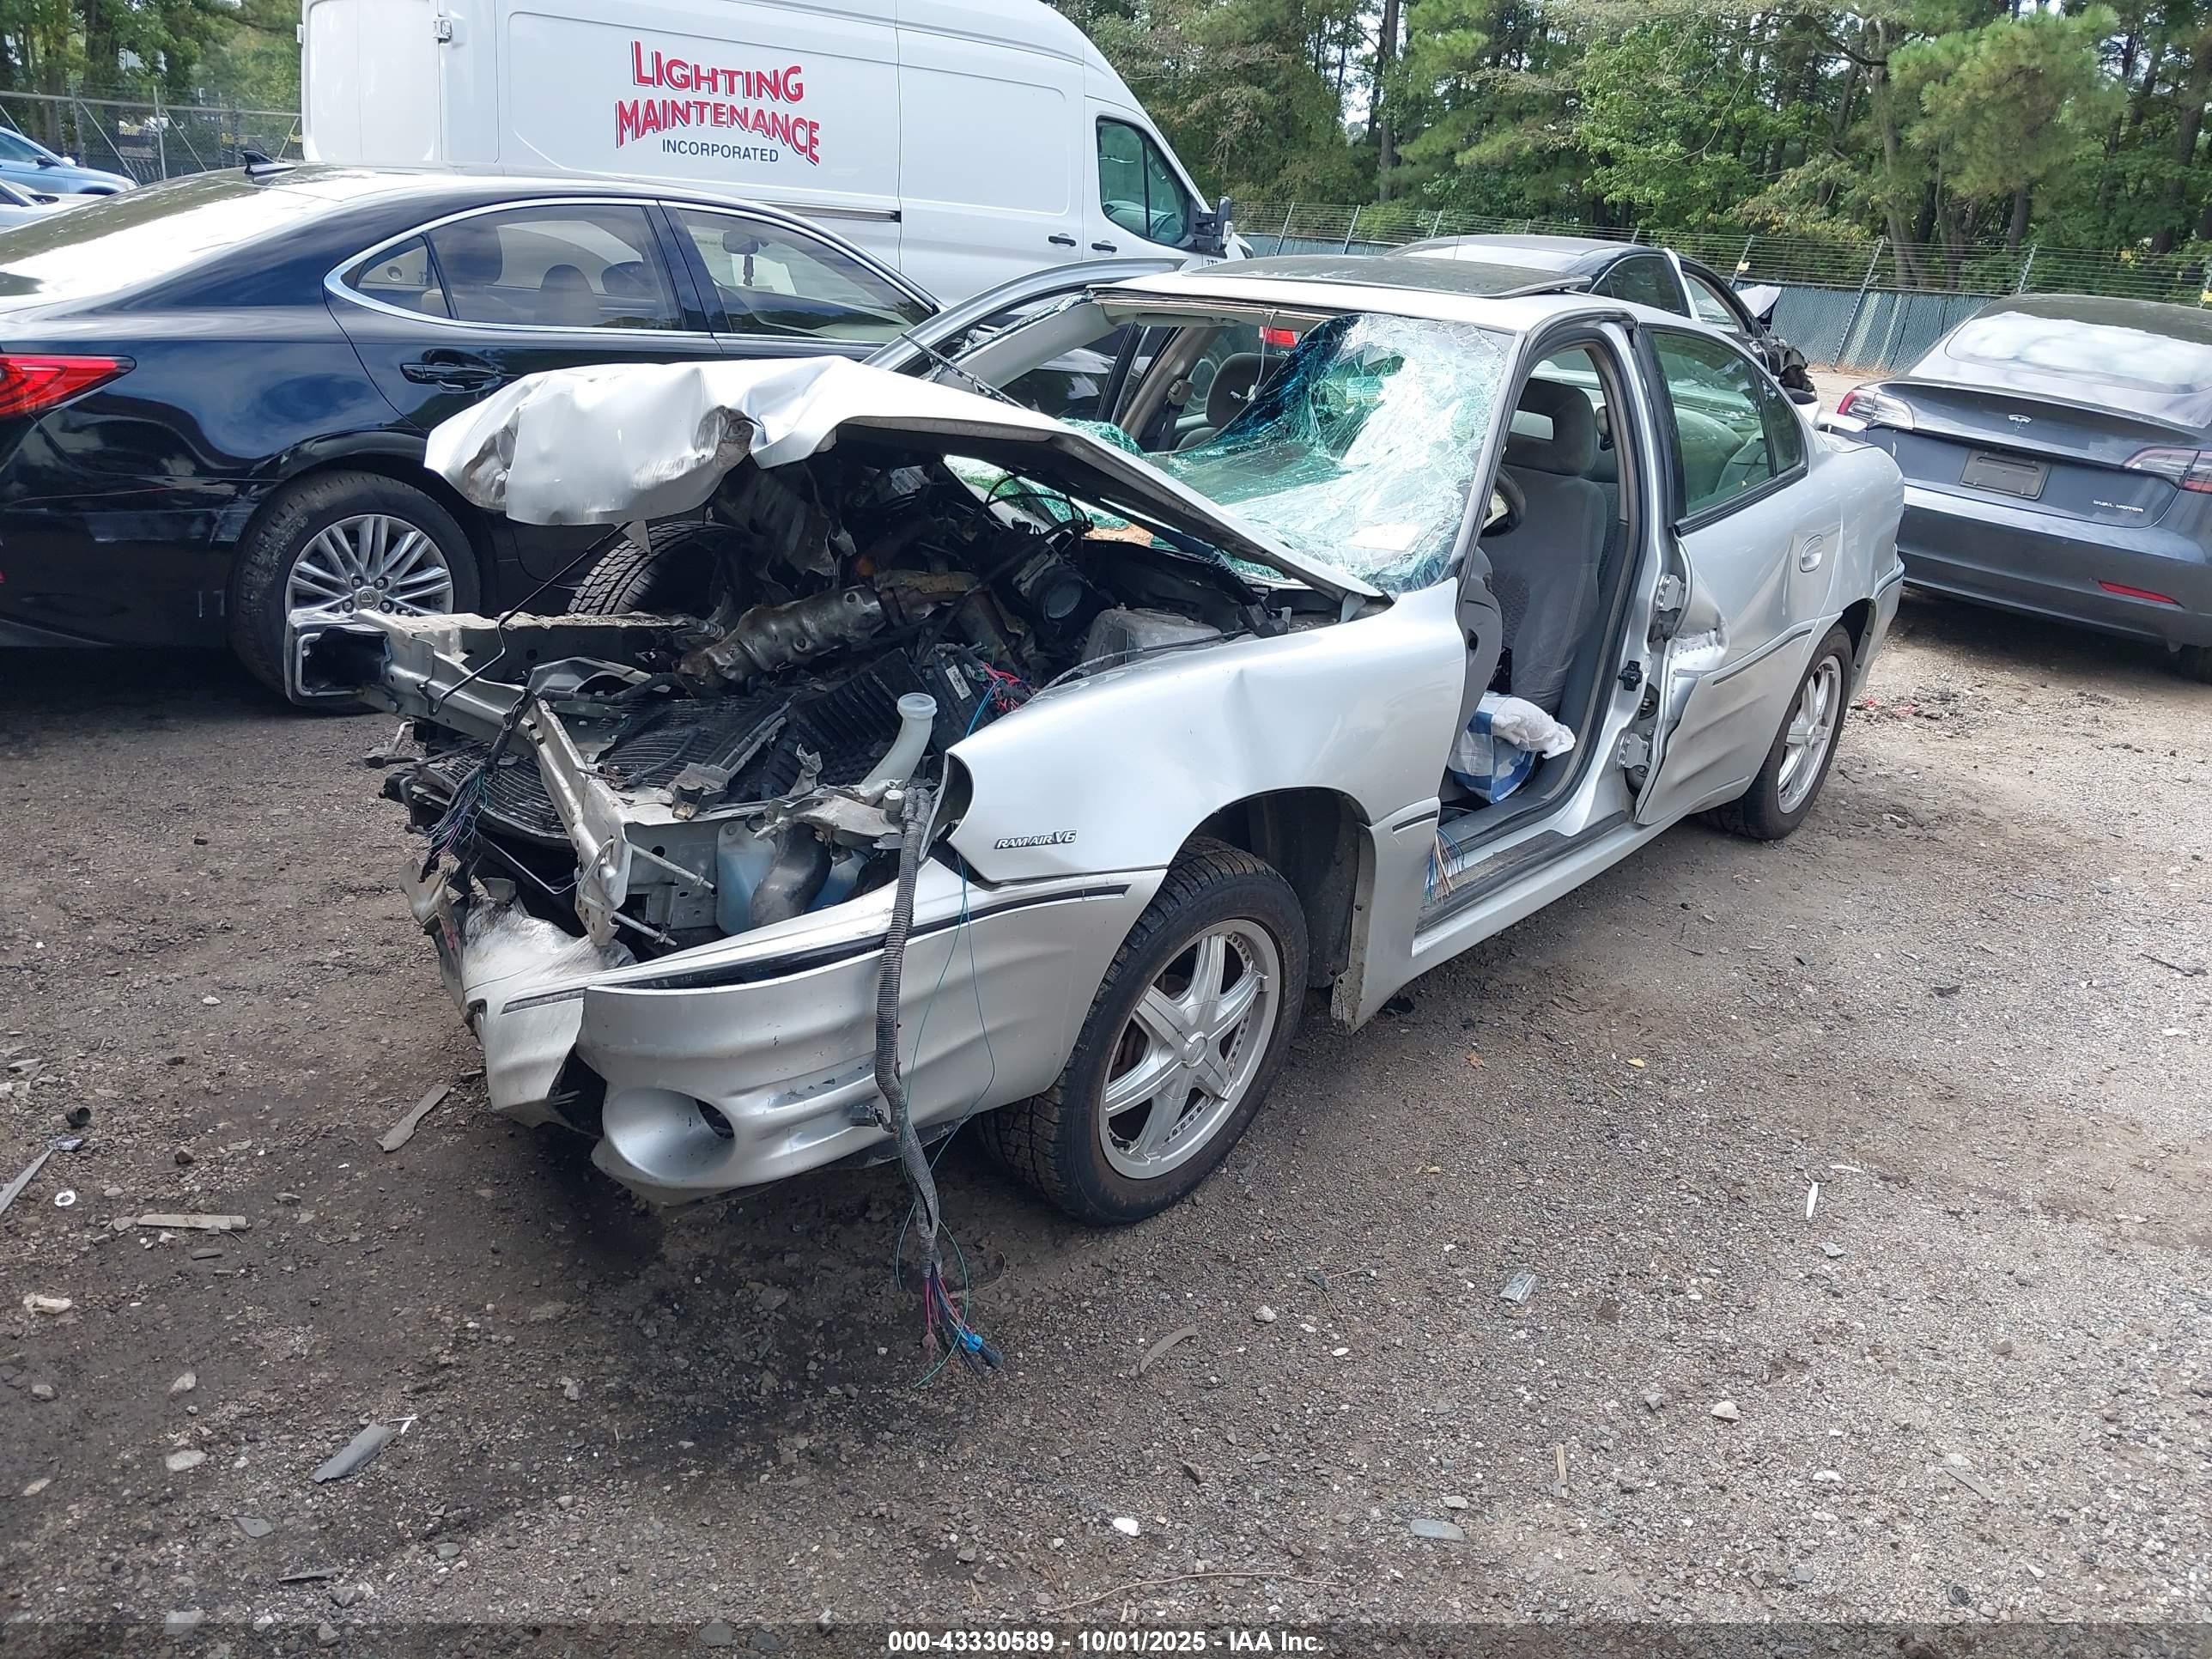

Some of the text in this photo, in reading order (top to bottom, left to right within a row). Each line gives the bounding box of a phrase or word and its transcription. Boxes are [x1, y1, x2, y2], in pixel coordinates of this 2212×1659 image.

[630, 40, 804, 104] LIGHTING
[615, 99, 820, 167] MAINTENANCE
[661, 138, 779, 162] INCORPORATED
[2115, 504, 2144, 513] MOTOR
[994, 830, 1077, 849] RAM AIR V6
